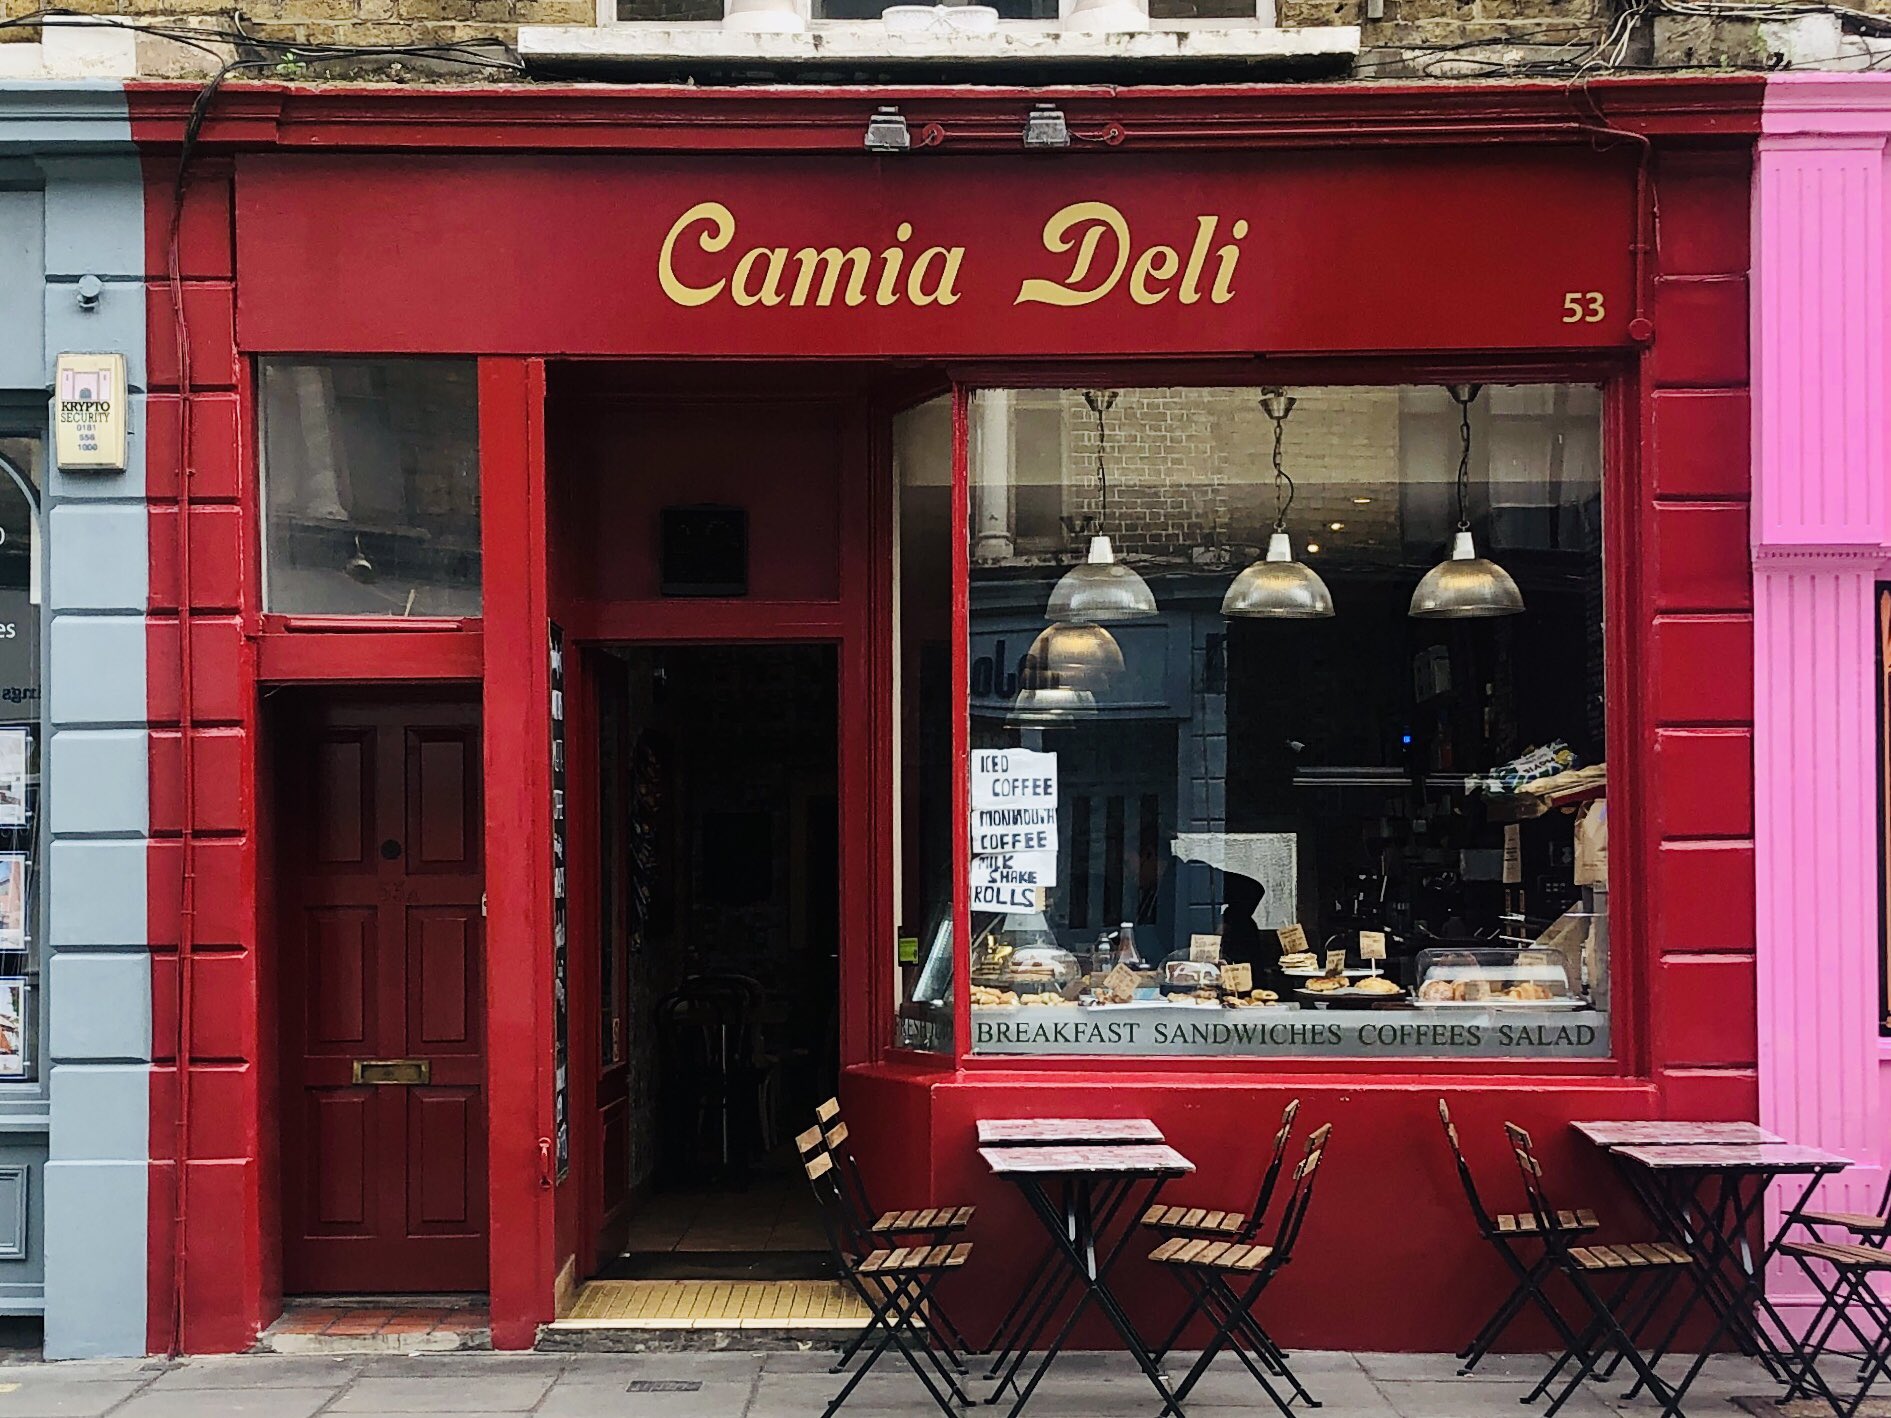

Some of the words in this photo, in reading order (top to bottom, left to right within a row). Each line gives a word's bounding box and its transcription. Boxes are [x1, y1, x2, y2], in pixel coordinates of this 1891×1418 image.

[659, 201, 966, 306] Camia
[1013, 201, 1249, 306] Deli
[1562, 292, 1605, 323] 53
[61, 401, 110, 412] KRYPTO
[60, 412, 110, 423] SECURITY
[76, 424, 96, 432] 0181
[980, 755, 1009, 773] ICED
[992, 778, 1053, 797] COFFEE
[980, 831, 1047, 850] COFFEE
[978, 854, 1014, 871] MILK
[987, 870, 1038, 884] SHAKE
[974, 886, 1035, 908] ROLLS
[976, 1022, 1141, 1044] BREAKFAST
[1154, 1022, 1342, 1046] SANDWICHES
[1358, 1023, 1482, 1047] COFFEES
[1499, 1023, 1596, 1047] SALAD
